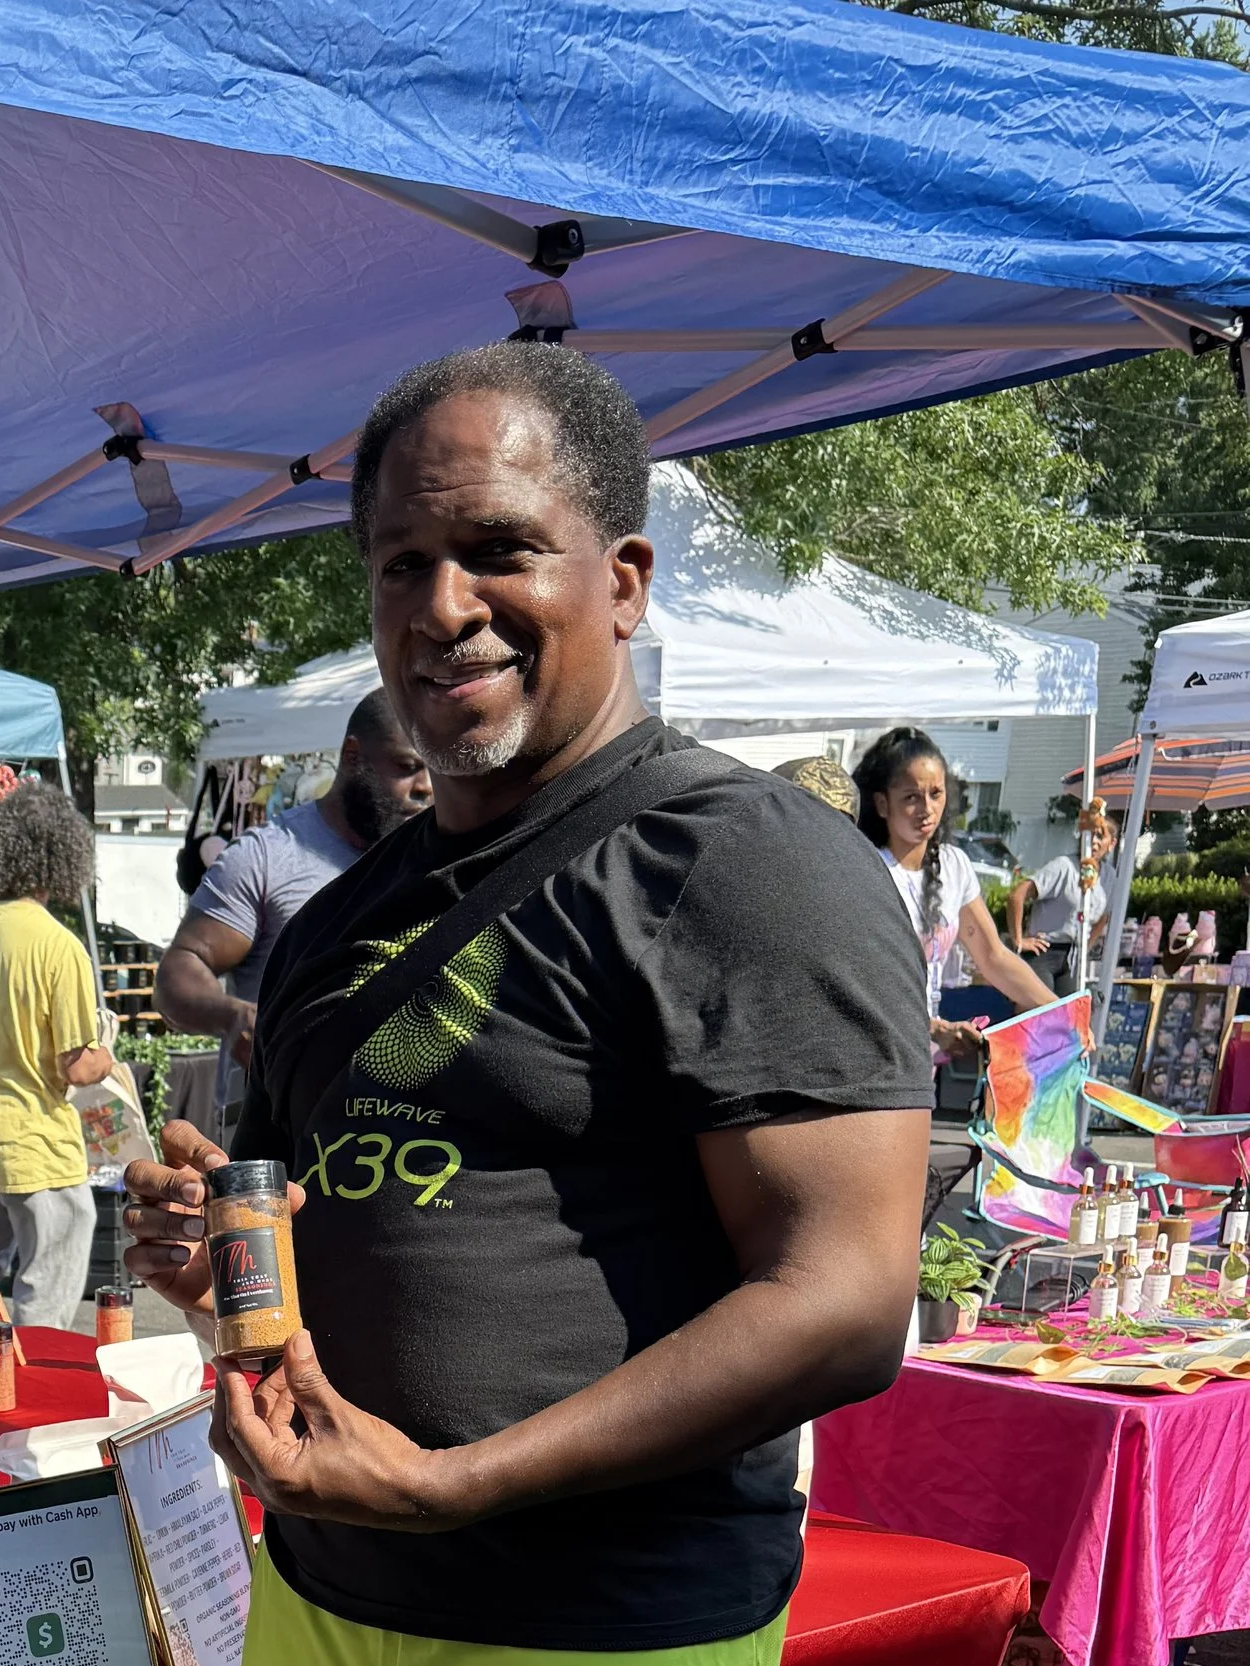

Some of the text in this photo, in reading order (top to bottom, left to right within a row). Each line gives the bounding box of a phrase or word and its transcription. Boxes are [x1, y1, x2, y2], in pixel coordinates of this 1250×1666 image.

[345, 1098, 446, 1125] LIFEWAVE
[18, 1513, 44, 1528] with
[45, 1508, 73, 1523] Cash
